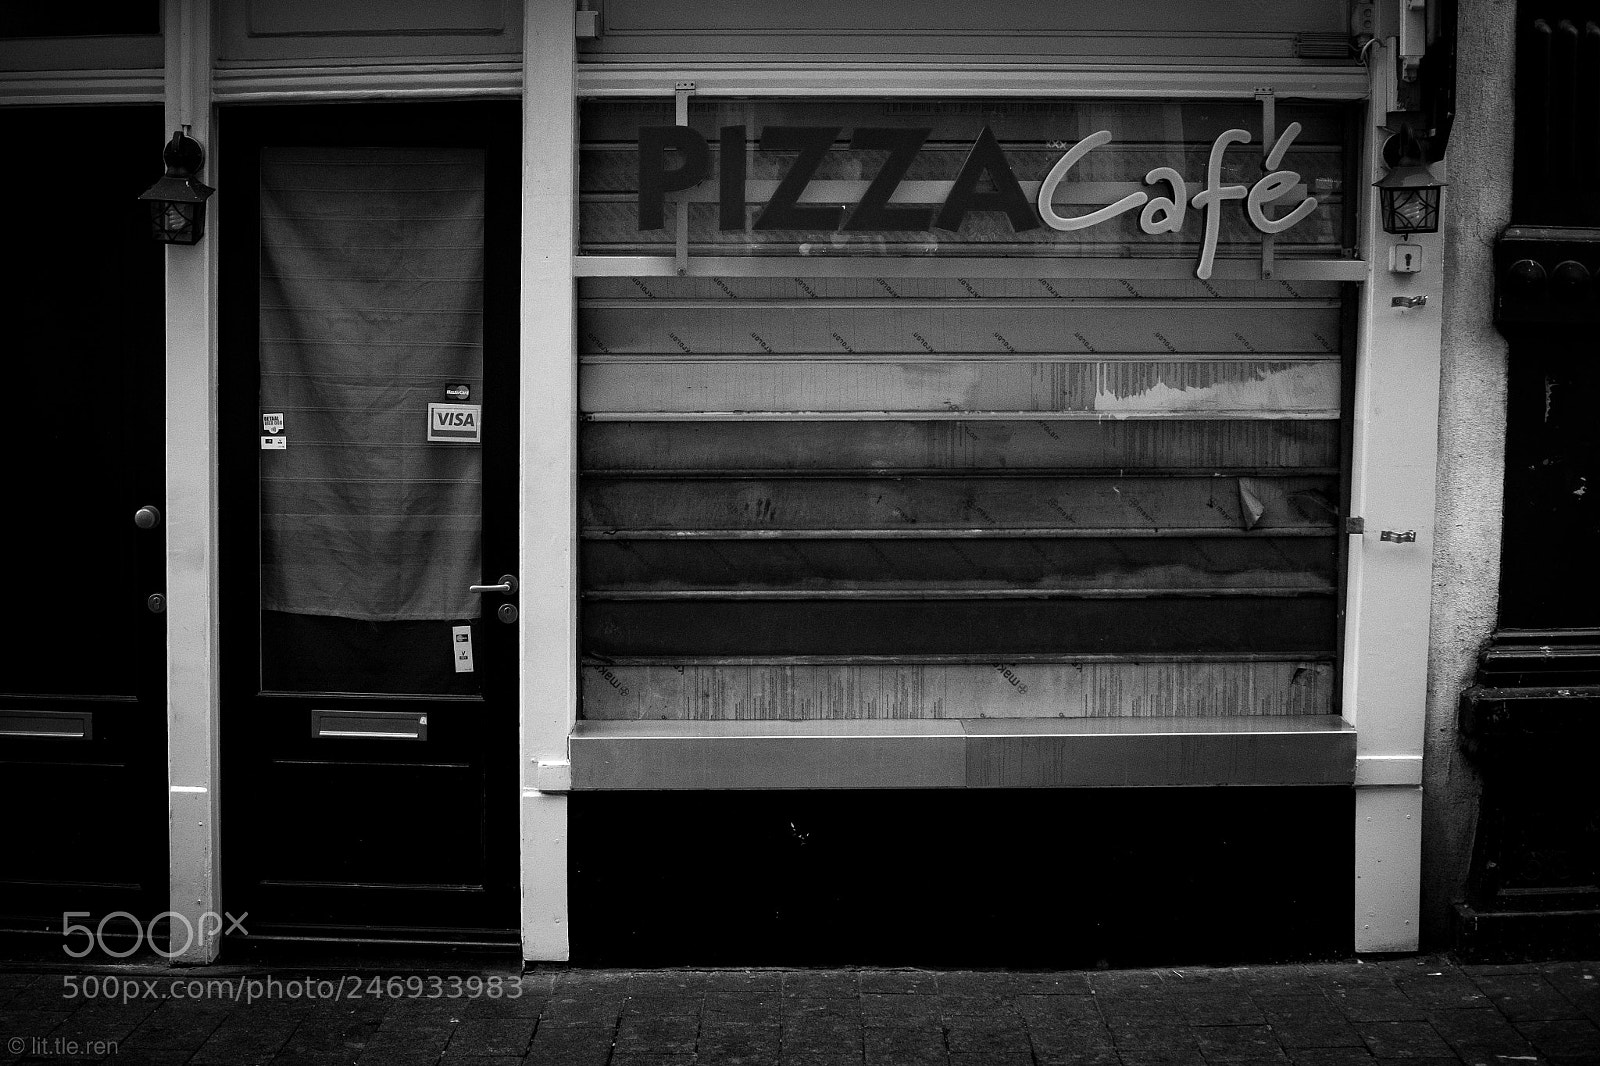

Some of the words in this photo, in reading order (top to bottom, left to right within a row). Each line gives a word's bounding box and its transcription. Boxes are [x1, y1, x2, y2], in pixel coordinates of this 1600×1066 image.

[638, 124, 1040, 232] PIZZA
[1038, 121, 1318, 280] Café
[437, 412, 474, 427] VISA
